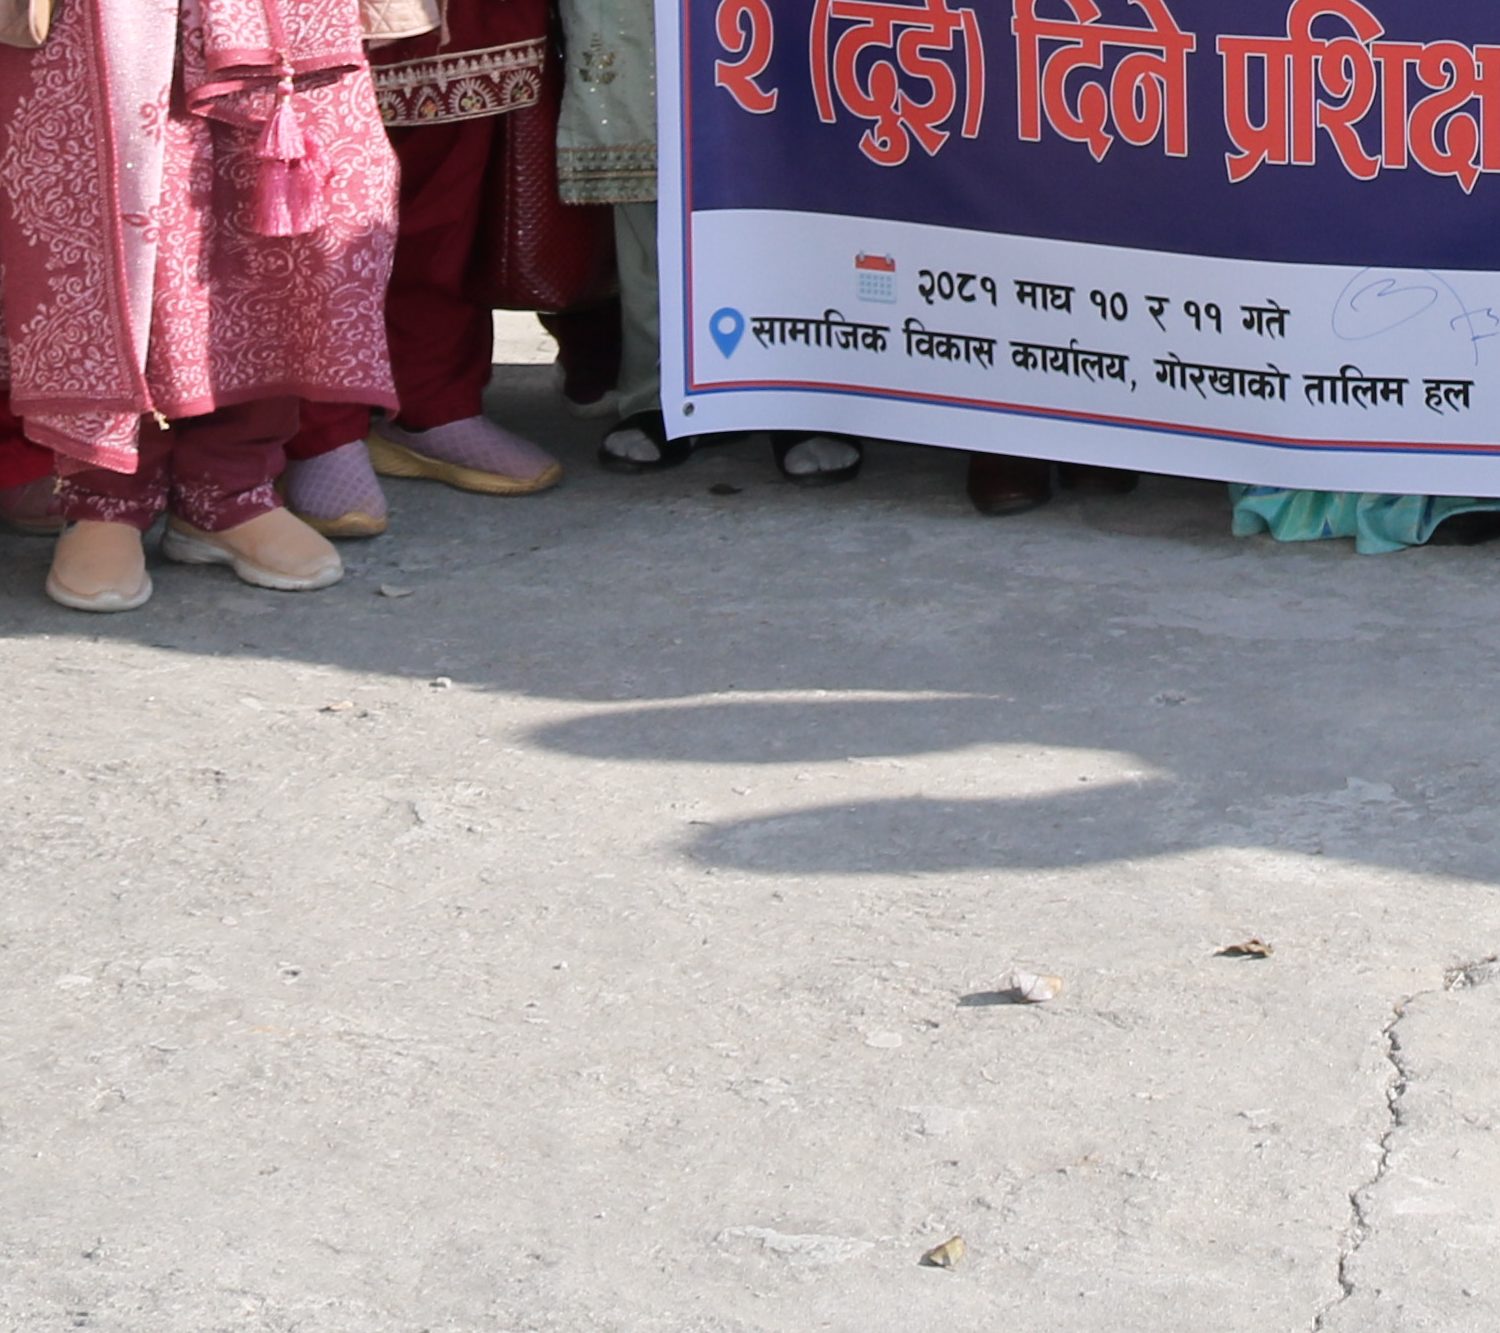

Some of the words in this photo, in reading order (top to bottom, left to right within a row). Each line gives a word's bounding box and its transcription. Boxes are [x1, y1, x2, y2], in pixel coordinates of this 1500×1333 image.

[917, 268, 998, 308] २०८१
[1012, 279, 1076, 315] माघ
[1089, 288, 1129, 322] १०
[1143, 294, 1171, 332] र
[1182, 299, 1223, 335] ११
[1240, 298, 1291, 339] गते
[750, 307, 891, 353] सामाजिक
[901, 317, 998, 370] विकास
[1008, 338, 1138, 394] कार्यालय,
[1152, 351, 1292, 402] गोरखाको
[1302, 363, 1410, 410] तालिम
[1421, 378, 1475, 415] हल
